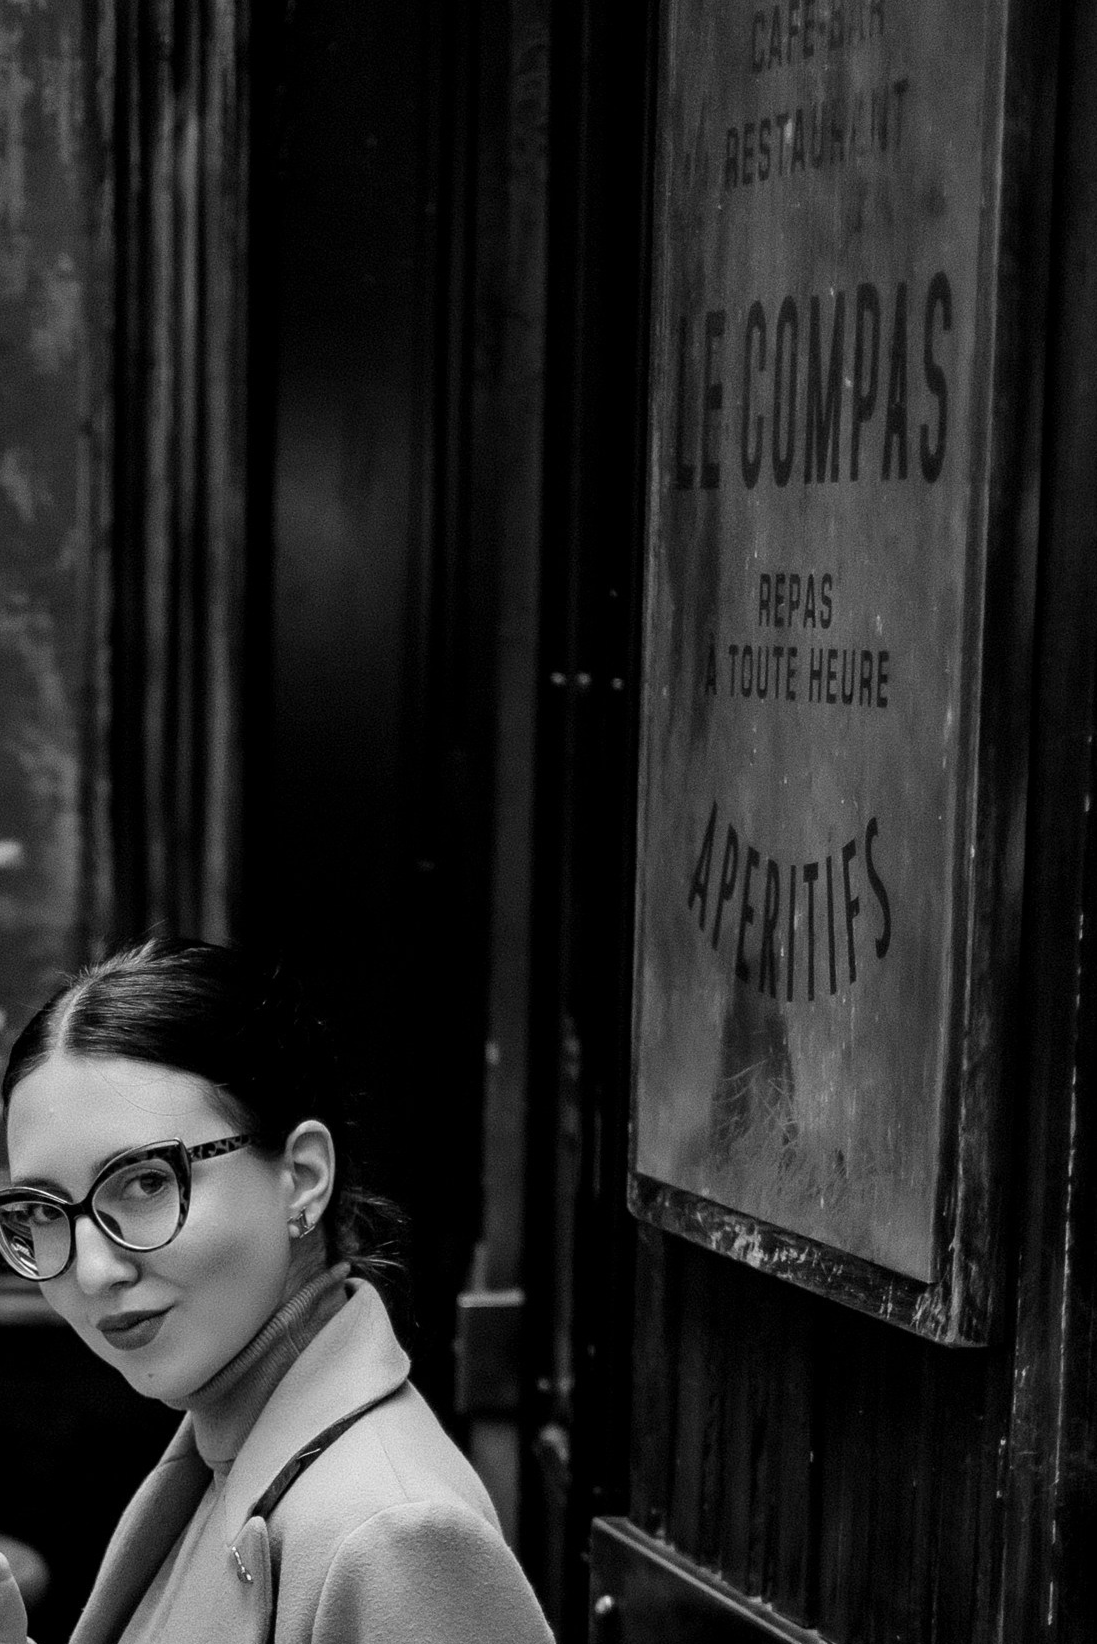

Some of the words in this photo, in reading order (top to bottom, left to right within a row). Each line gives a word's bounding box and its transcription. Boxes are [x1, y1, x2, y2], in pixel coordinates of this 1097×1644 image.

[675, 308, 726, 491] LE
[740, 270, 953, 490] COMPAS
[758, 572, 833, 629] REPAS
[728, 644, 798, 701] TOUTE
[809, 648, 890, 709] HEURE
